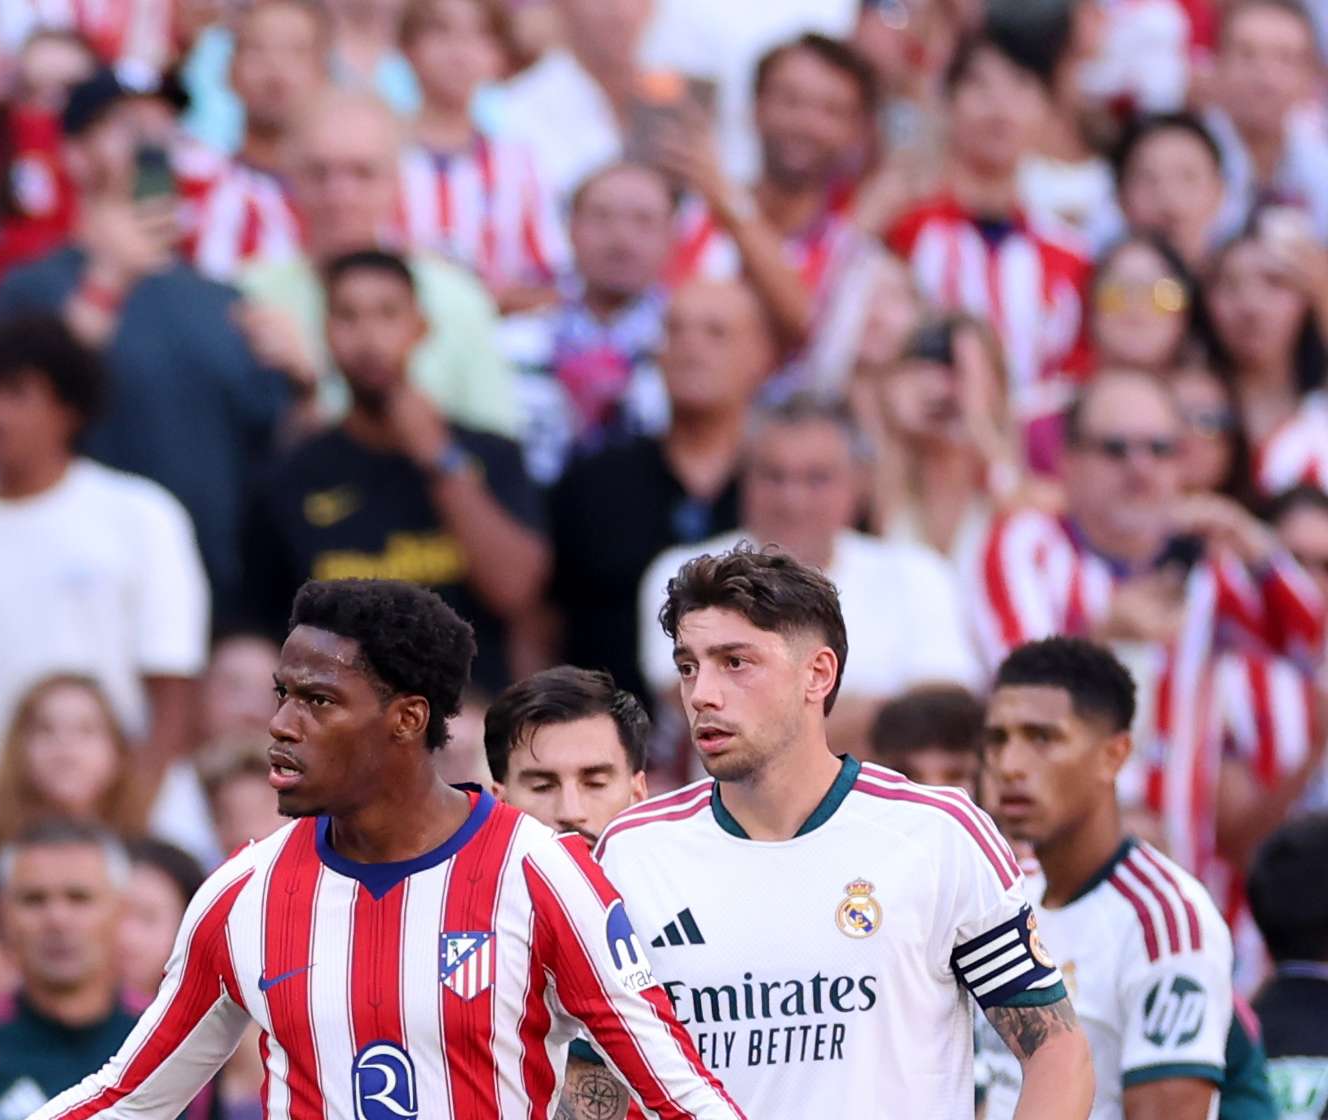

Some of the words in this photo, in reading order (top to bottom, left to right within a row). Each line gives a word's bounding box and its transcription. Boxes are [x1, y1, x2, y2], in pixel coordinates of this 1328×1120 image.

[662, 969, 877, 1025] Emirates
[698, 1030, 737, 1069] FLY
[747, 1023, 846, 1067] BETTER
